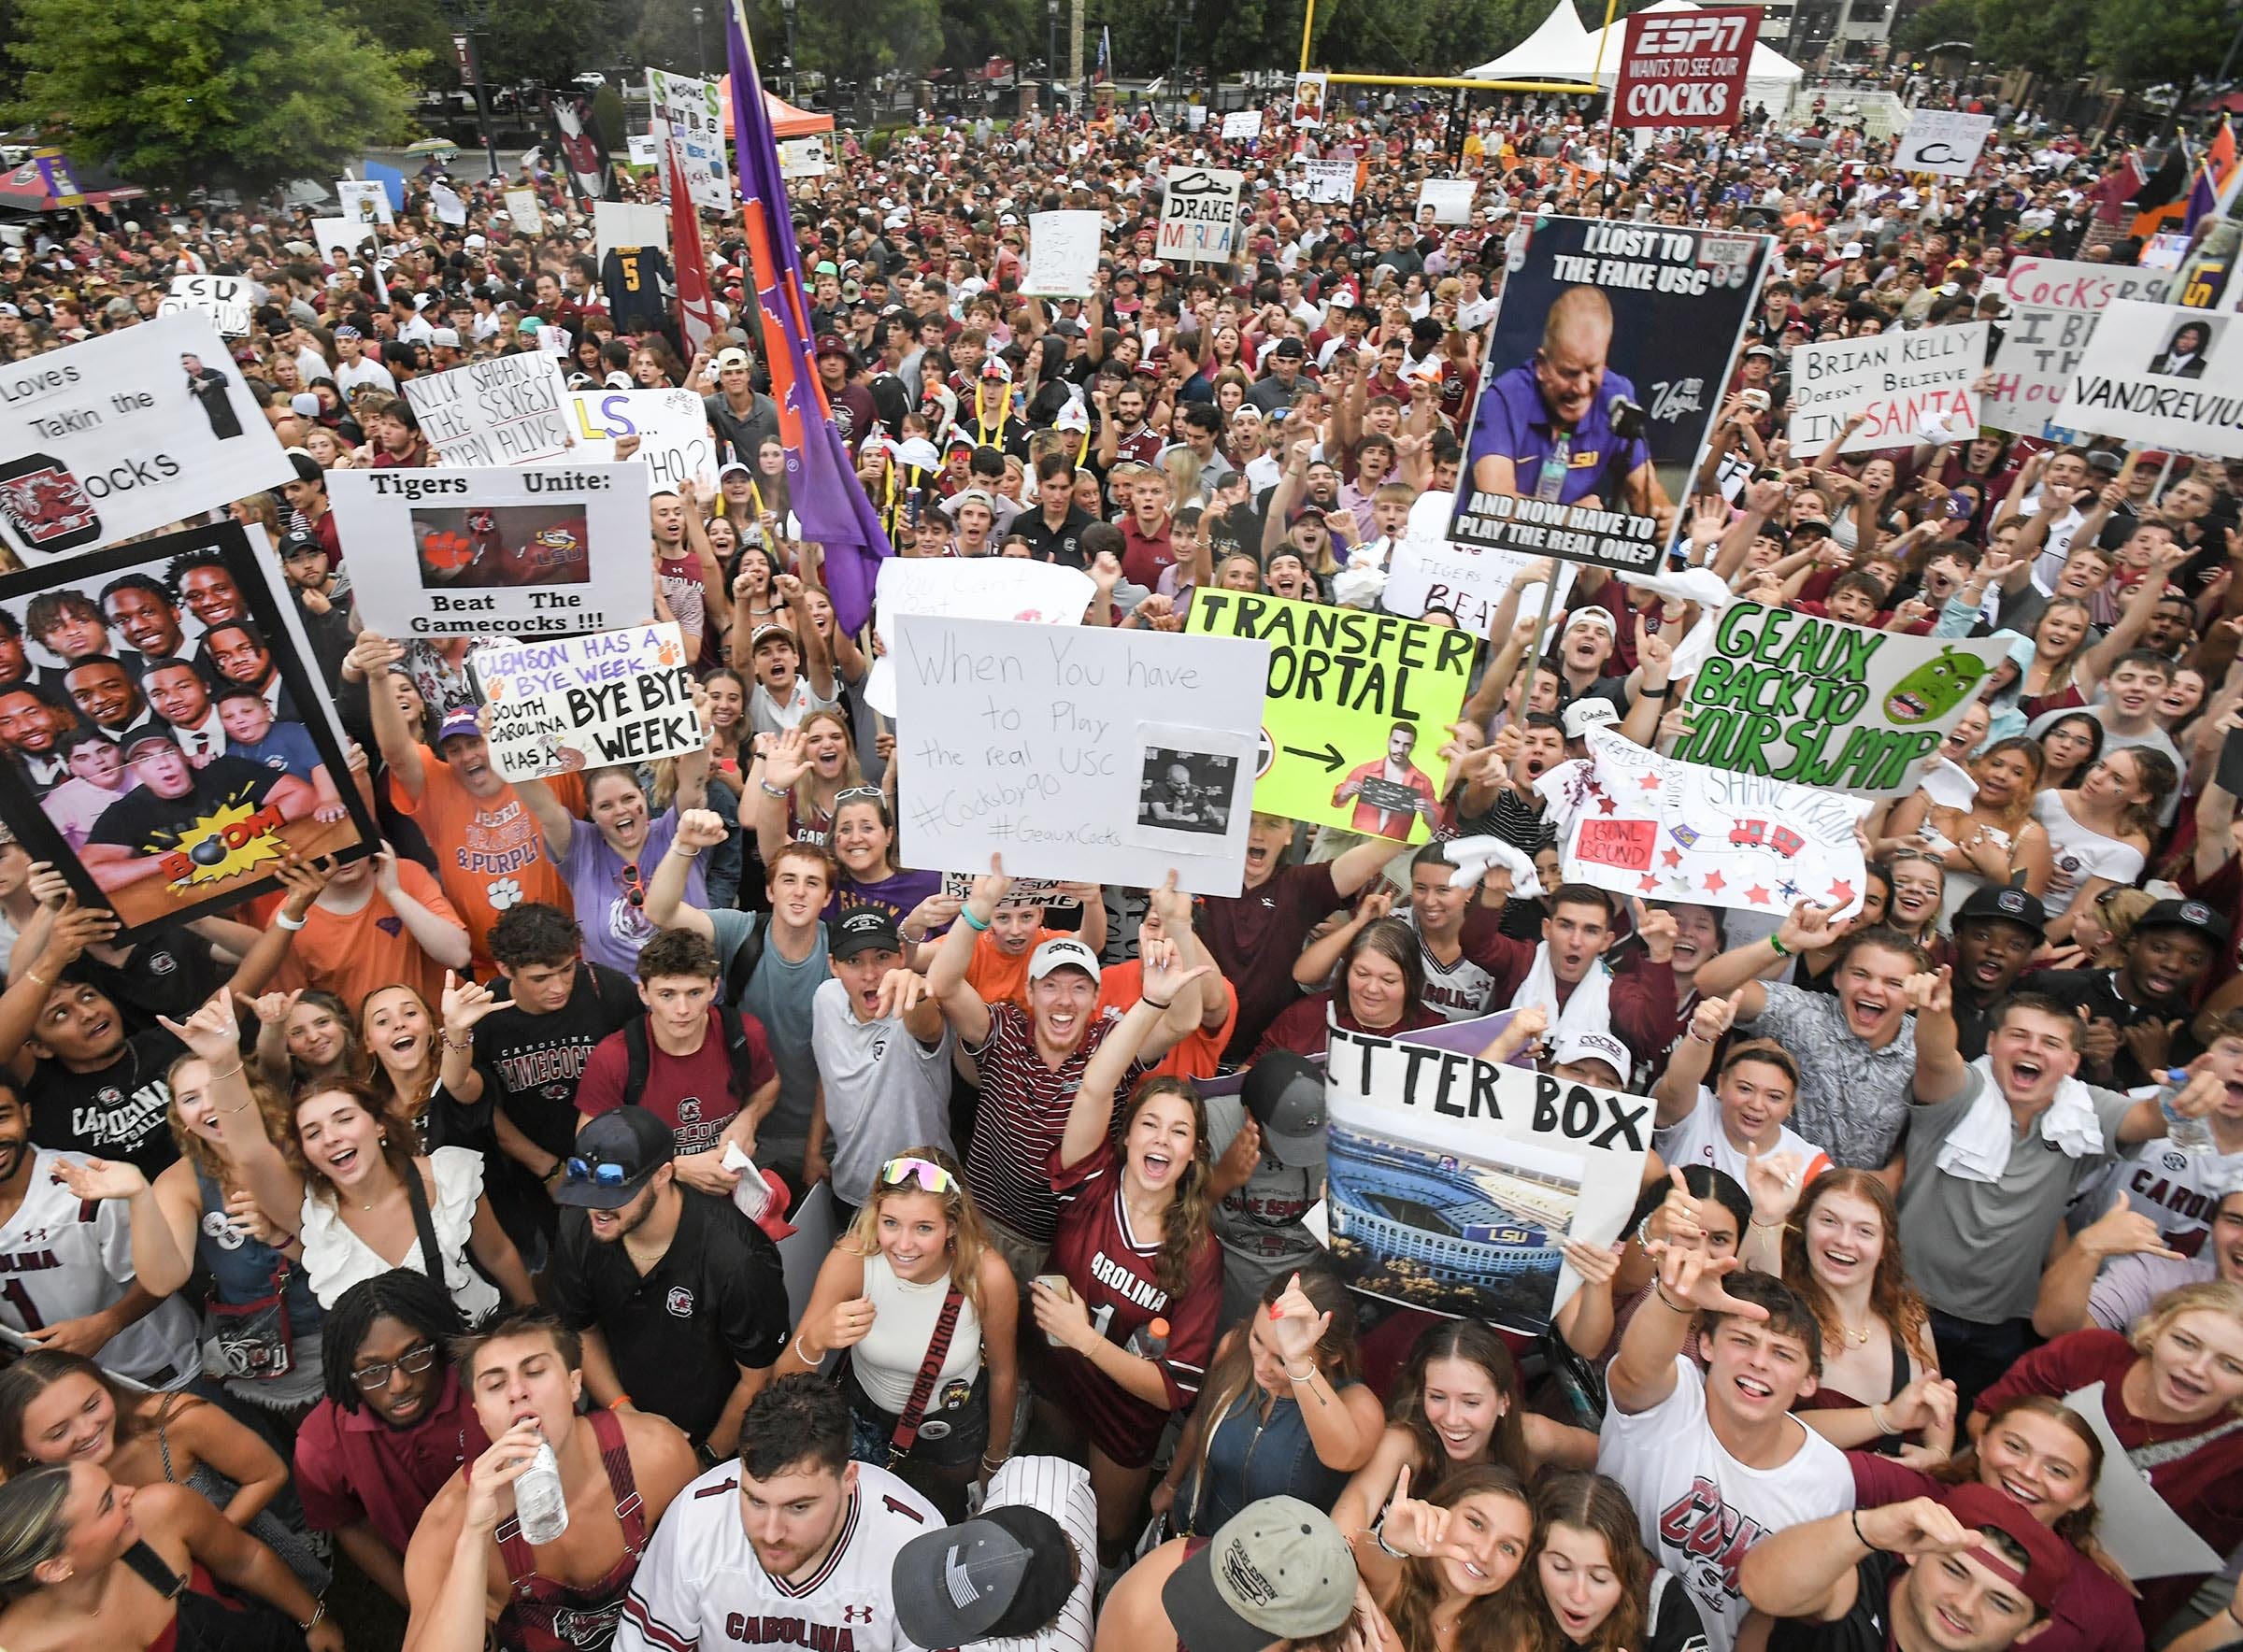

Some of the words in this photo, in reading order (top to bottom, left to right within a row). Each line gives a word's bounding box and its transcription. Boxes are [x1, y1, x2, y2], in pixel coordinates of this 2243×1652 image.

[1635, 17, 1747, 54] ESPN
[1629, 59, 1672, 78] WANTS
[1672, 59, 1690, 77] TO
[1689, 57, 1712, 77] SEE
[1711, 57, 1739, 77] OUR
[1627, 82, 1728, 117] COCKS
[1168, 197, 1234, 222] DRAKE
[1596, 227, 1659, 258] LOST
[1660, 234, 1693, 262] TO
[621, 257, 640, 293] 5
[1552, 254, 1595, 284] THE
[1596, 261, 1656, 291] FAKE
[1656, 266, 1710, 296] USC
[2014, 313, 2054, 344] I
[2059, 311, 2102, 348] BE
[468, 357, 537, 392] SABAN
[540, 351, 556, 375] IS
[1807, 348, 1898, 380] BRIAN
[1902, 329, 1979, 363] KELLY
[2034, 349, 2080, 374] TH
[0, 363, 82, 403] Loves
[28, 407, 103, 439] Takin
[110, 389, 155, 414] the
[419, 406, 471, 440] THE
[478, 377, 560, 425] SEXIEST
[1802, 412, 1850, 444] IN
[1864, 387, 1977, 439] SANTA
[497, 416, 565, 455] ALIVE
[643, 438, 707, 484] HO?
[370, 473, 468, 500] Tigers
[522, 471, 611, 494] Unite:
[1469, 491, 1510, 520] AND
[1515, 499, 1565, 528] NOW
[1568, 507, 1625, 536] HAVE
[1626, 514, 1657, 540] TO
[1455, 515, 1507, 540] PLAY
[1507, 523, 1547, 547] THE
[1544, 528, 1595, 558] REAL
[1599, 536, 1656, 566] ONE?
[1419, 558, 1481, 582] TIGERS
[432, 595, 495, 612] Beat
[529, 591, 581, 610] The
[1424, 583, 1498, 629] BEA
[410, 614, 567, 634] Gamecocks
[579, 612, 605, 631] !!!
[1202, 594, 1473, 676] TRANSFER
[1715, 602, 1888, 682] GEAUX
[477, 644, 569, 679] CLEMSON
[583, 633, 631, 660] HAS
[643, 628, 661, 647] A
[905, 627, 1024, 687] When
[1048, 634, 1106, 687] You
[1125, 645, 1201, 691] have
[490, 696, 548, 723] SOUTH
[567, 681, 632, 729] BYE
[636, 665, 693, 713] BYE
[516, 674, 572, 698] BYE
[1266, 644, 1422, 722] ORTAL
[1692, 656, 1811, 719] BACK
[1807, 676, 1870, 726] TO
[489, 716, 567, 744] CAROLINA
[980, 694, 1021, 732] to
[1050, 700, 1111, 745] Play
[501, 748, 541, 773] HAS
[545, 746, 562, 766] A
[593, 710, 703, 762] WEEK!
[916, 739, 964, 768] the
[985, 745, 1033, 768] real
[1058, 747, 1116, 777] USC
[1672, 703, 1790, 776] YOUR
[1773, 720, 1943, 790] SWAMP
[796, 828, 828, 846] CAR
[1593, 820, 1642, 843] BOWL
[1789, 790, 1857, 845] TRAIN
[1579, 842, 1646, 865] BOUND
[996, 894, 1077, 908] FTIME
[501, 1035, 593, 1058] CAROLINA
[1578, 1034, 1622, 1057] COCKS
[493, 1045, 598, 1093] AMECOC
[1532, 1074, 1650, 1152] BOX
[1489, 1227, 1528, 1245] LSU
[1091, 1250, 1168, 1313] AROLINA
[929, 1302, 962, 1359] SOUTH
[901, 1360, 942, 1430] CAROLINA
[694, 1475, 738, 1500] 1
[882, 1495, 925, 1525] 1
[1232, 1538, 1279, 1601] CHARLESTON
[725, 1611, 861, 1652] CAROLINA
